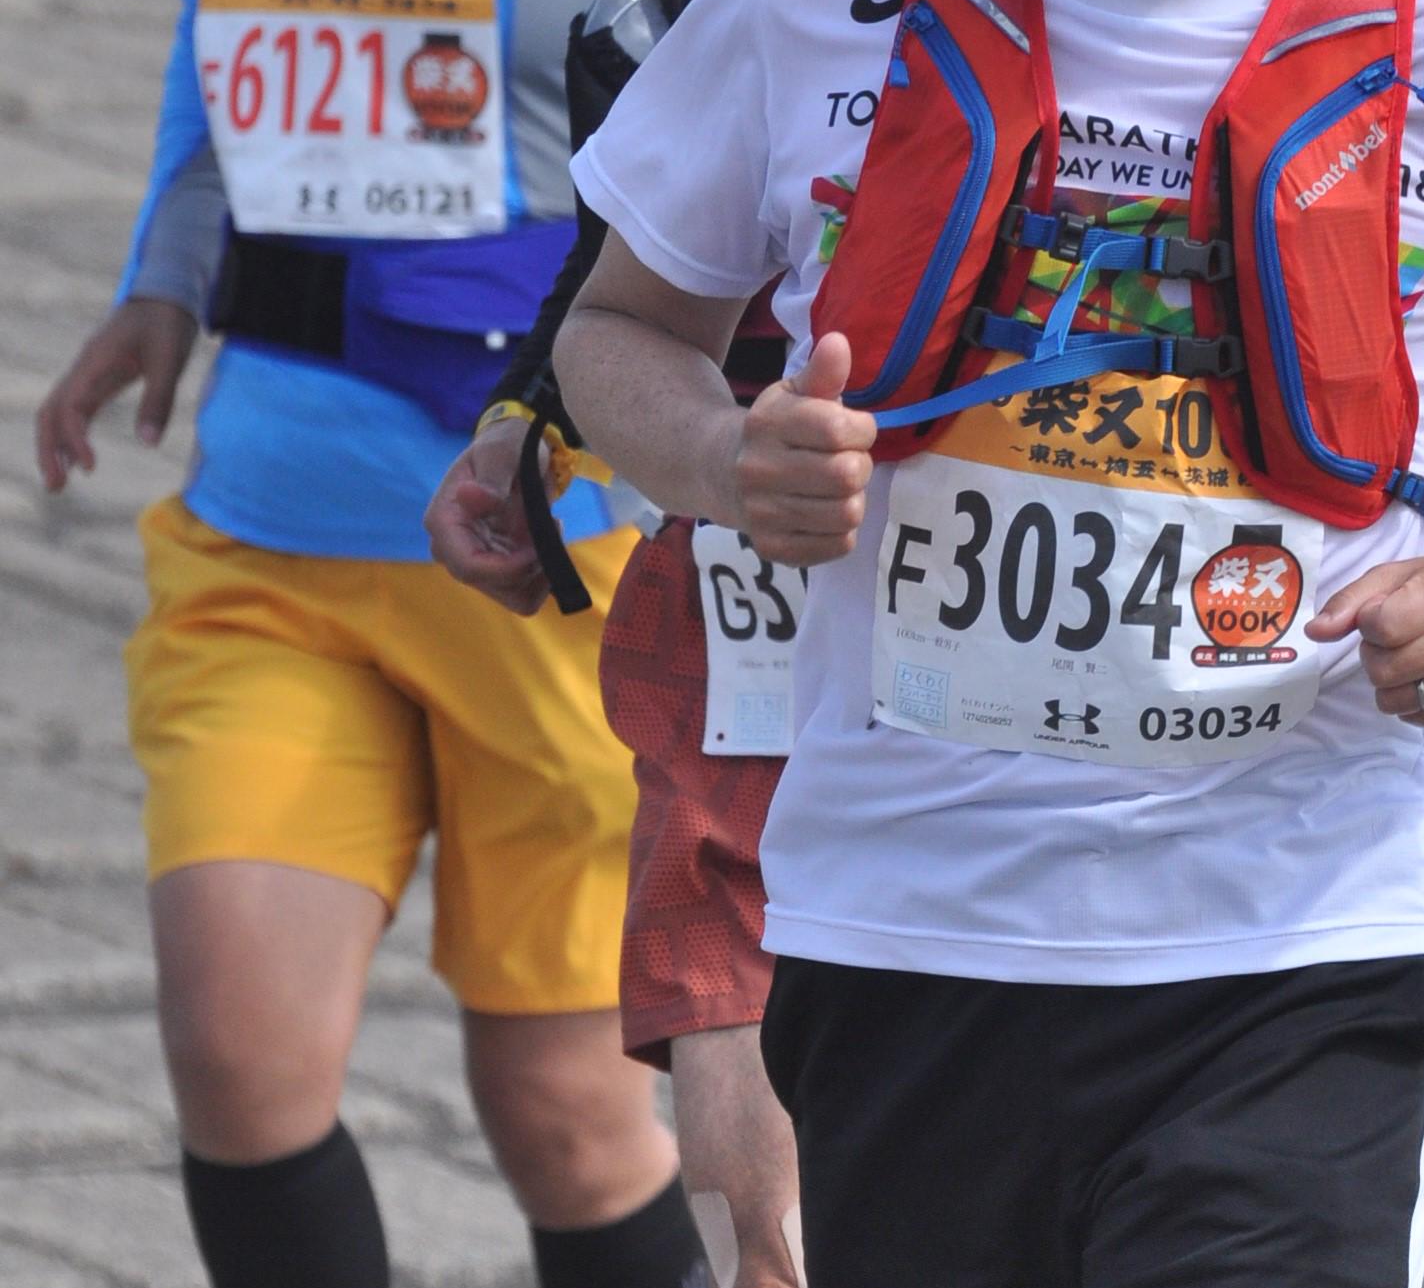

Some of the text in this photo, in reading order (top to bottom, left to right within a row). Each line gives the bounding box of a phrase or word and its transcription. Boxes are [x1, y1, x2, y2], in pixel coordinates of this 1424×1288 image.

[1112, 161, 1153, 186] WE
[365, 184, 474, 215] 06121
[1020, 382, 1232, 459] 柴又 10
[709, 531, 808, 641] G3
[888, 489, 1185, 660] F3034
[1208, 557, 1288, 599] 柴又
[1206, 609, 1284, 633] 100K
[1034, 733, 1067, 743] UNDER
[1139, 702, 1282, 742] 03034
